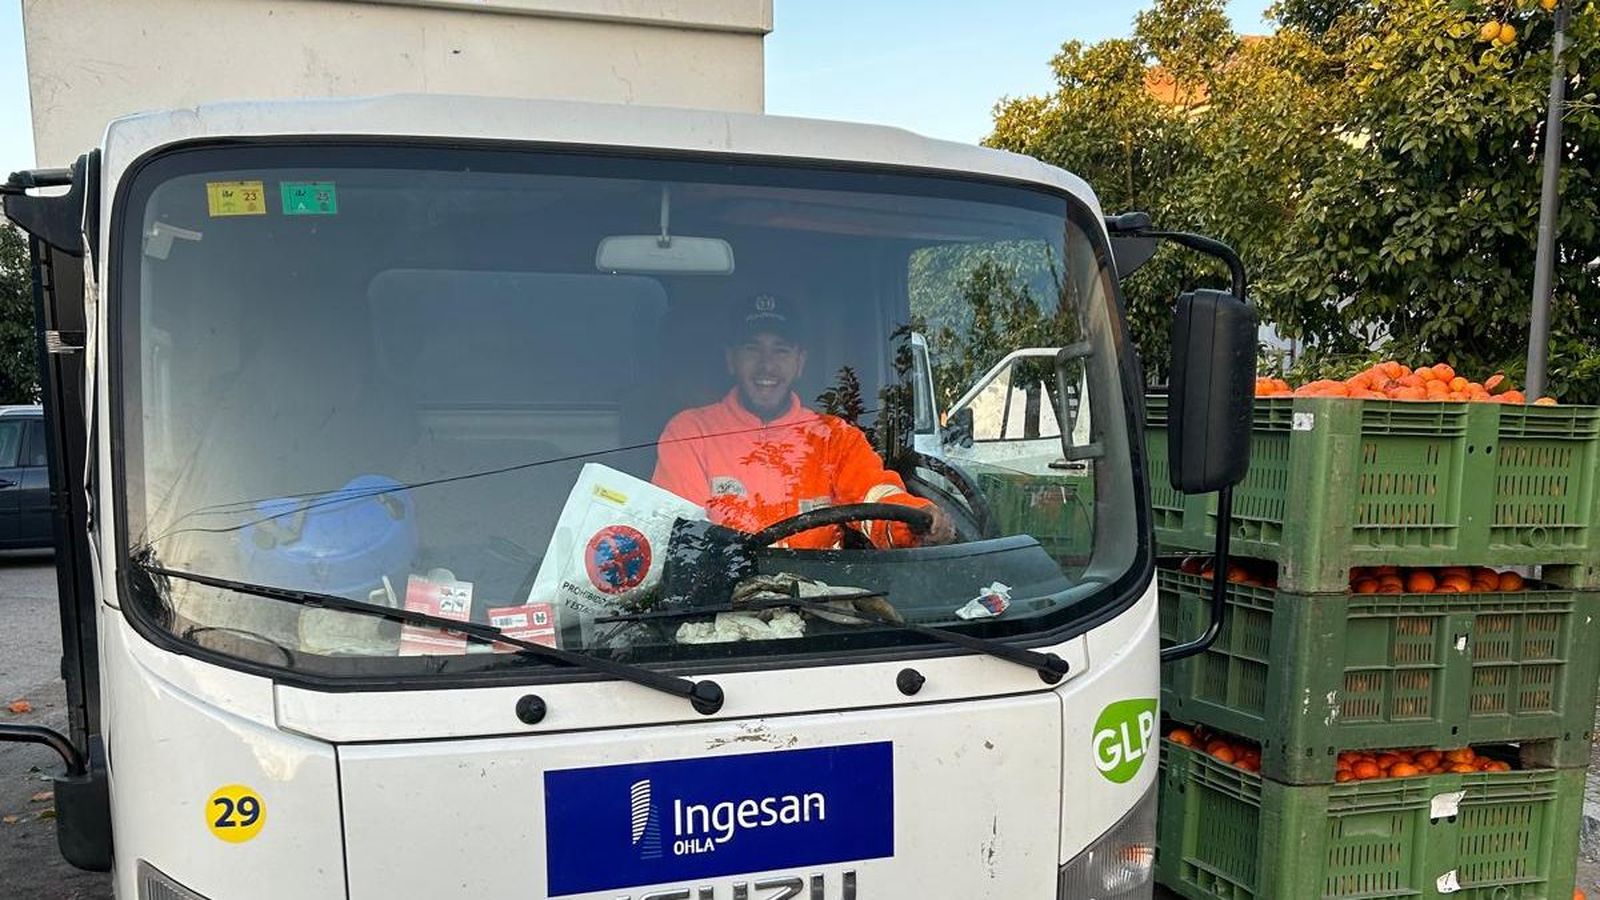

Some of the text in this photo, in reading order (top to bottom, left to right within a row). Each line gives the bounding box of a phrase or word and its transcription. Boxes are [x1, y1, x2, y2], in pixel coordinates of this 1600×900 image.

[243, 192, 257, 201] 23
[1093, 710, 1154, 772] GLP
[213, 796, 261, 828] 29
[673, 791, 826, 844] Ingesan
[673, 838, 716, 856] OHLA
